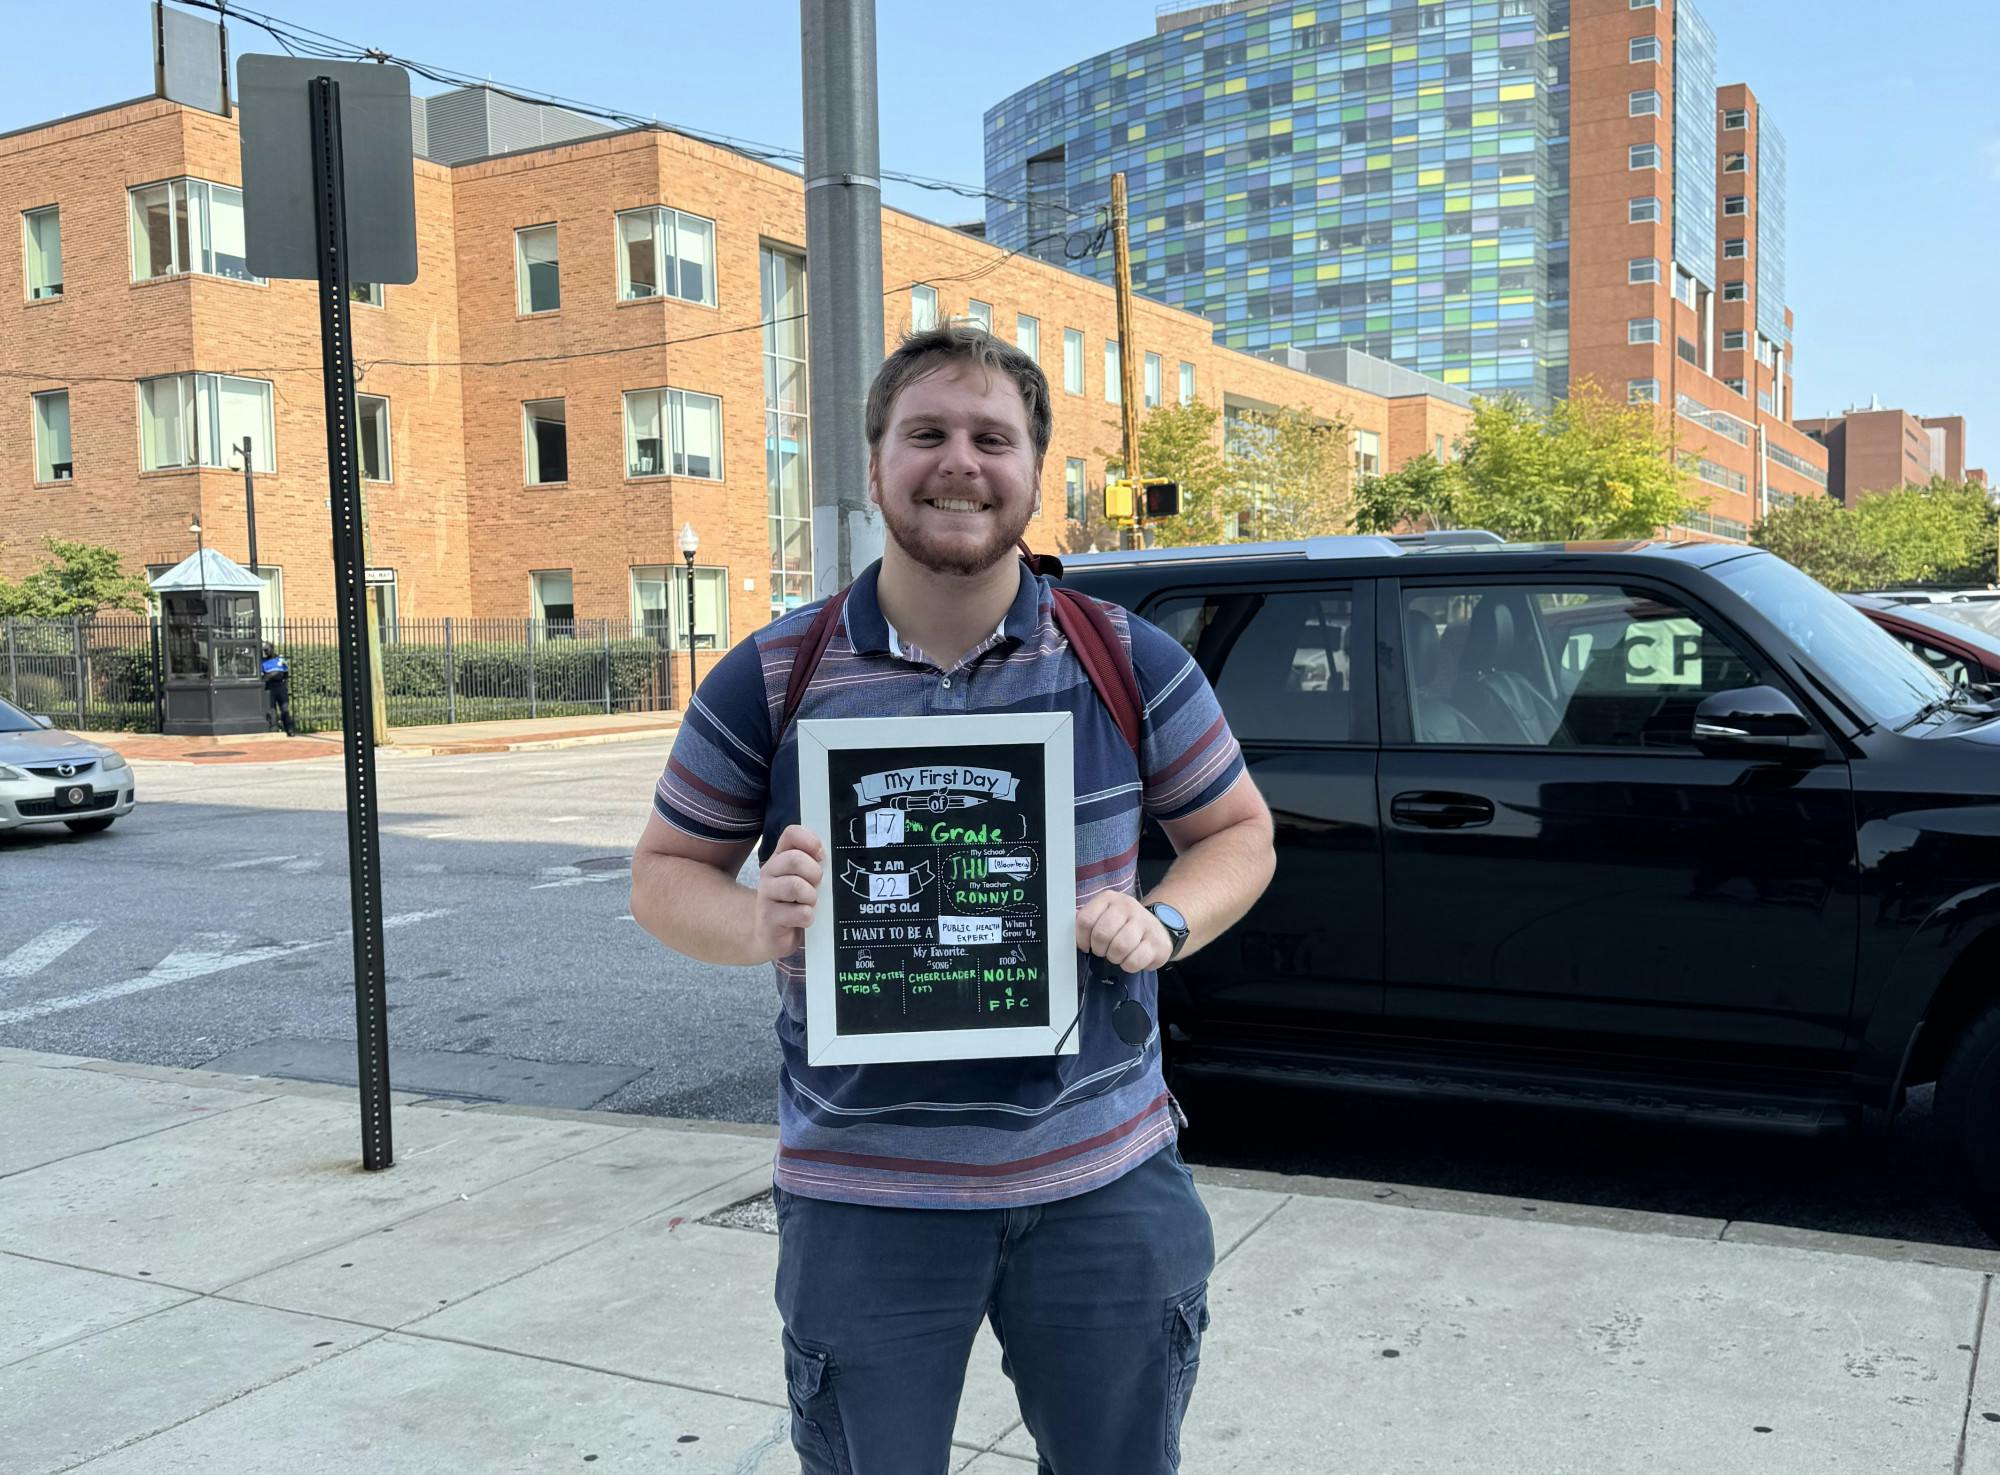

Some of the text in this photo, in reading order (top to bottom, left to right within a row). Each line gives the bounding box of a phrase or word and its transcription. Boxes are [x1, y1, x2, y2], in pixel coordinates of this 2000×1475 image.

[884, 769, 999, 791] My First Day
[931, 796, 945, 810] of
[875, 813, 896, 834] 17
[931, 821, 1003, 843] Grade
[983, 848, 1006, 856] School
[873, 861, 882, 872] I
[875, 877, 903, 897] 22
[969, 881, 1009, 890] My Teacher
[859, 903, 897, 914] years
[942, 923, 1001, 933] PUBLIC HEALTH
[1005, 919, 1033, 928] When I
[843, 926, 934, 941] I WANT TO BE A
[1002, 928, 1037, 939] Grow Up
[913, 946, 927, 959] My
[855, 960, 875, 969] BOOK
[931, 961, 950, 970] SONG
[999, 957, 1017, 966] FOOD
[839, 972, 871, 982] HARRY
[908, 968, 977, 984] CHEERLEADER
[983, 967, 1038, 983] NOLAN
